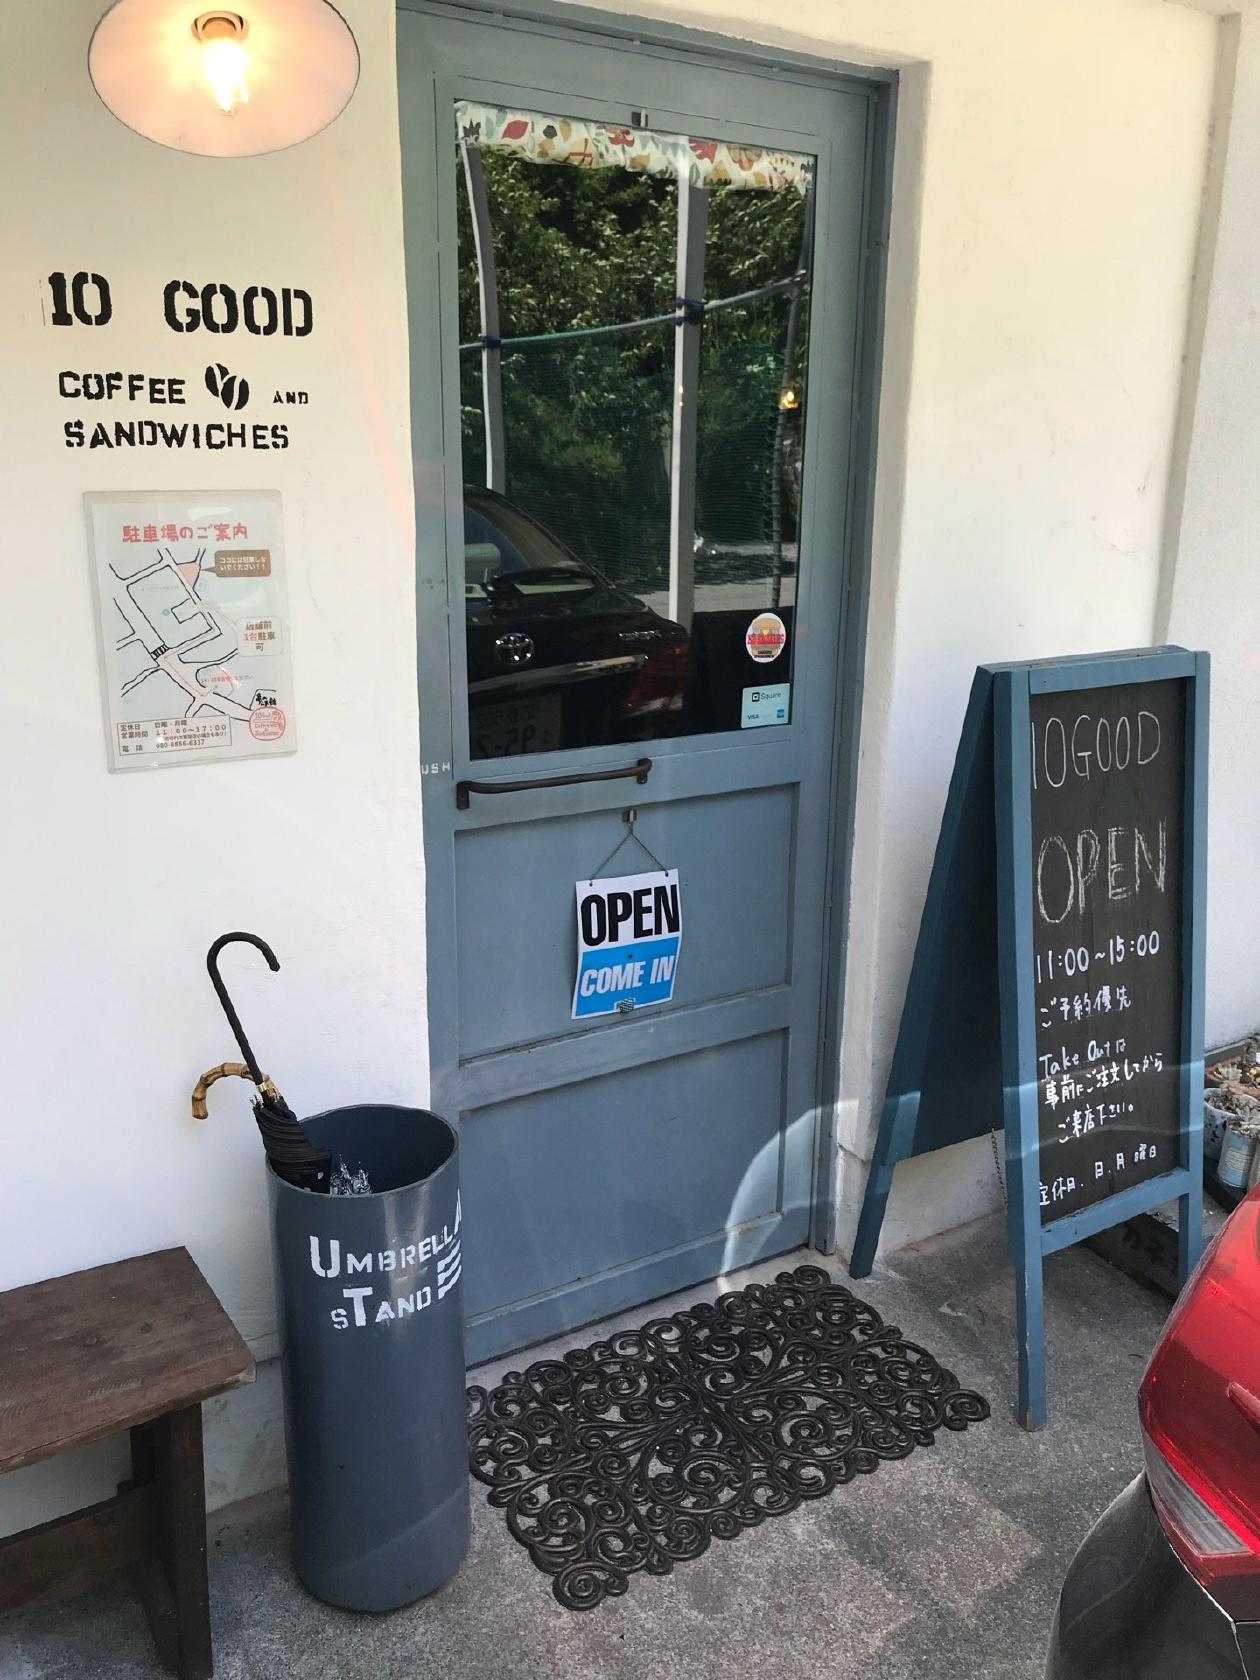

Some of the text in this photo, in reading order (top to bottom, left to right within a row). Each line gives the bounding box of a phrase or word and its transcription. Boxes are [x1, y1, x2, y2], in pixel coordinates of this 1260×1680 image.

[48, 271, 313, 337] 10 GOOD
[58, 371, 309, 404] COFFEE AND
[64, 419, 289, 449] SANDWICHES
[122, 522, 248, 543] 駐車場のご案内
[761, 692, 781, 700] Square
[120, 723, 141, 732] 定休日
[747, 713, 759, 721] VISA
[421, 761, 451, 775] USH
[1038, 816, 1167, 923] OPEN
[581, 884, 680, 947] OPEN
[580, 955, 675, 997] COME IN
[1040, 985, 1132, 1028] ご予約優先
[1039, 1047, 1080, 1083] Take
[1045, 1052, 1163, 1110] 事前にご注文してから
[1058, 1102, 1134, 1143] ご来店下さい。
[309, 1187, 462, 1278] UMBRELLA
